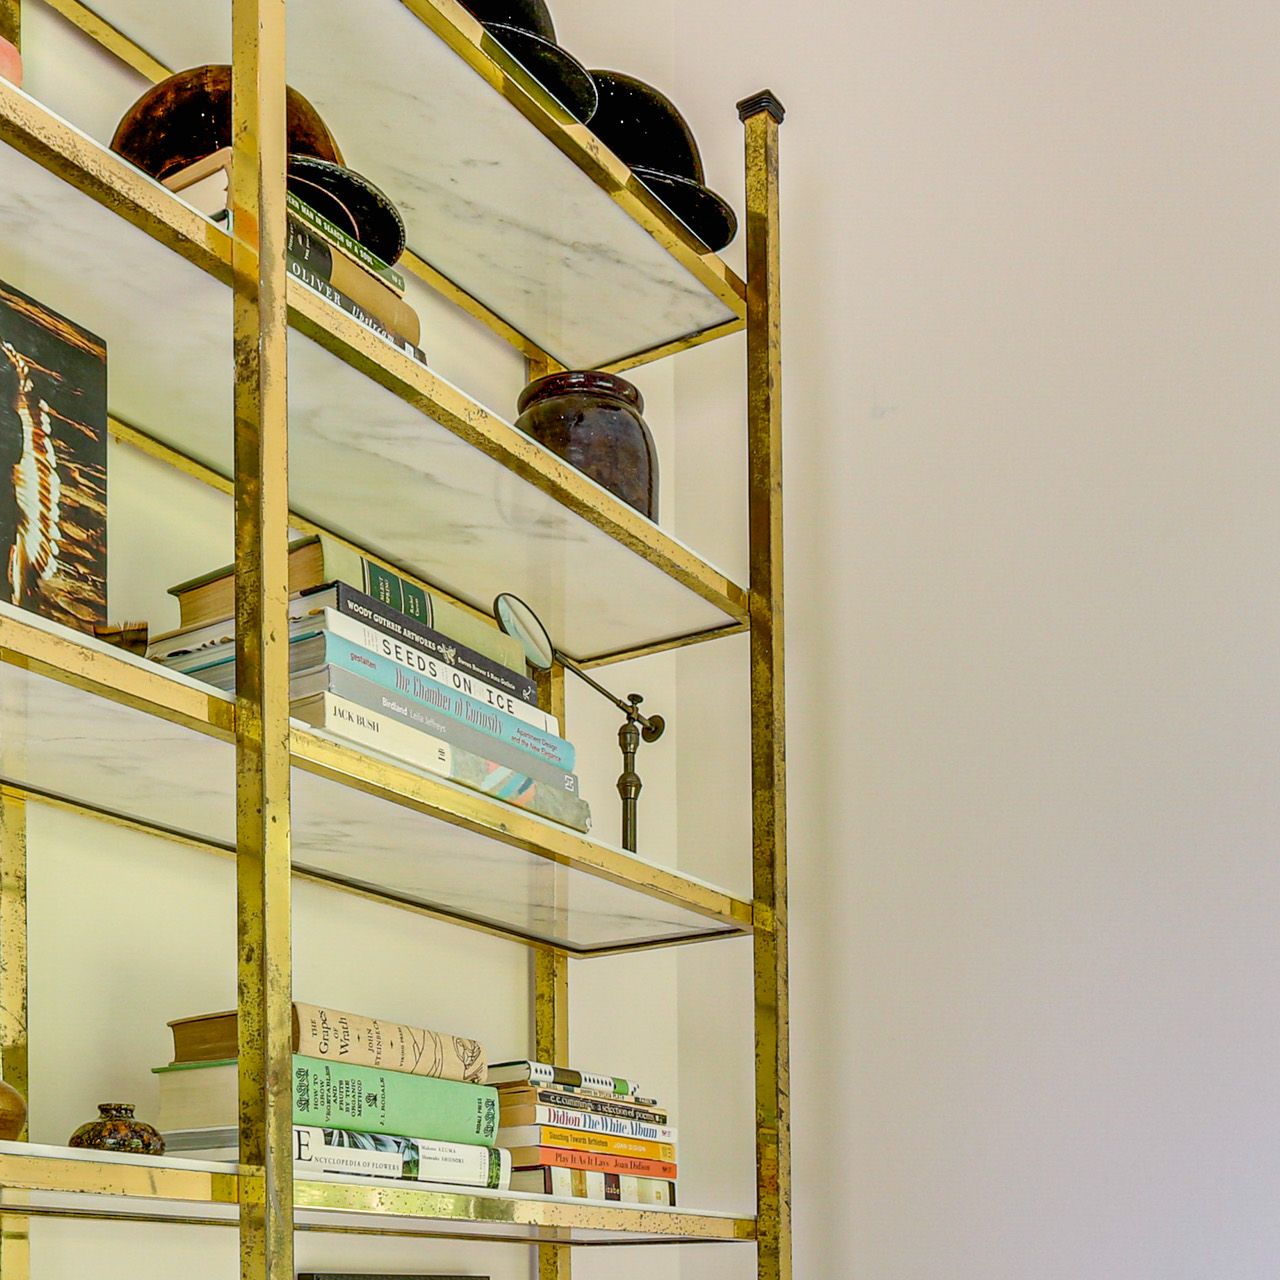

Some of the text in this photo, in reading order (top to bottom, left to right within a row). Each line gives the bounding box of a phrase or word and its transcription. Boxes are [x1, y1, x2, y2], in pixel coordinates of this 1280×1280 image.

[324, 219, 344, 246] SEARCH
[292, 262, 342, 306] OLIVER
[346, 600, 437, 652] WOODY GUTHRIE ARTWORKS
[382, 639, 515, 715] SEEDS ON ICE
[381, 696, 408, 716] Birdland
[413, 674, 451, 712] Chamber
[333, 705, 380, 733] JACK BUSH
[310, 1018, 318, 1037] THE
[318, 1010, 331, 1055] Grapes
[339, 1017, 350, 1056] Wrath
[366, 1028, 375, 1053] JOHN
[373, 1020, 382, 1066] STEINBECK
[313, 1073, 318, 1087] TO
[548, 1108, 658, 1139] Didion The White Album
[371, 1161, 400, 1171] FLOWERS
[555, 1153, 651, 1172] Play It As It Lays Joan Didion
